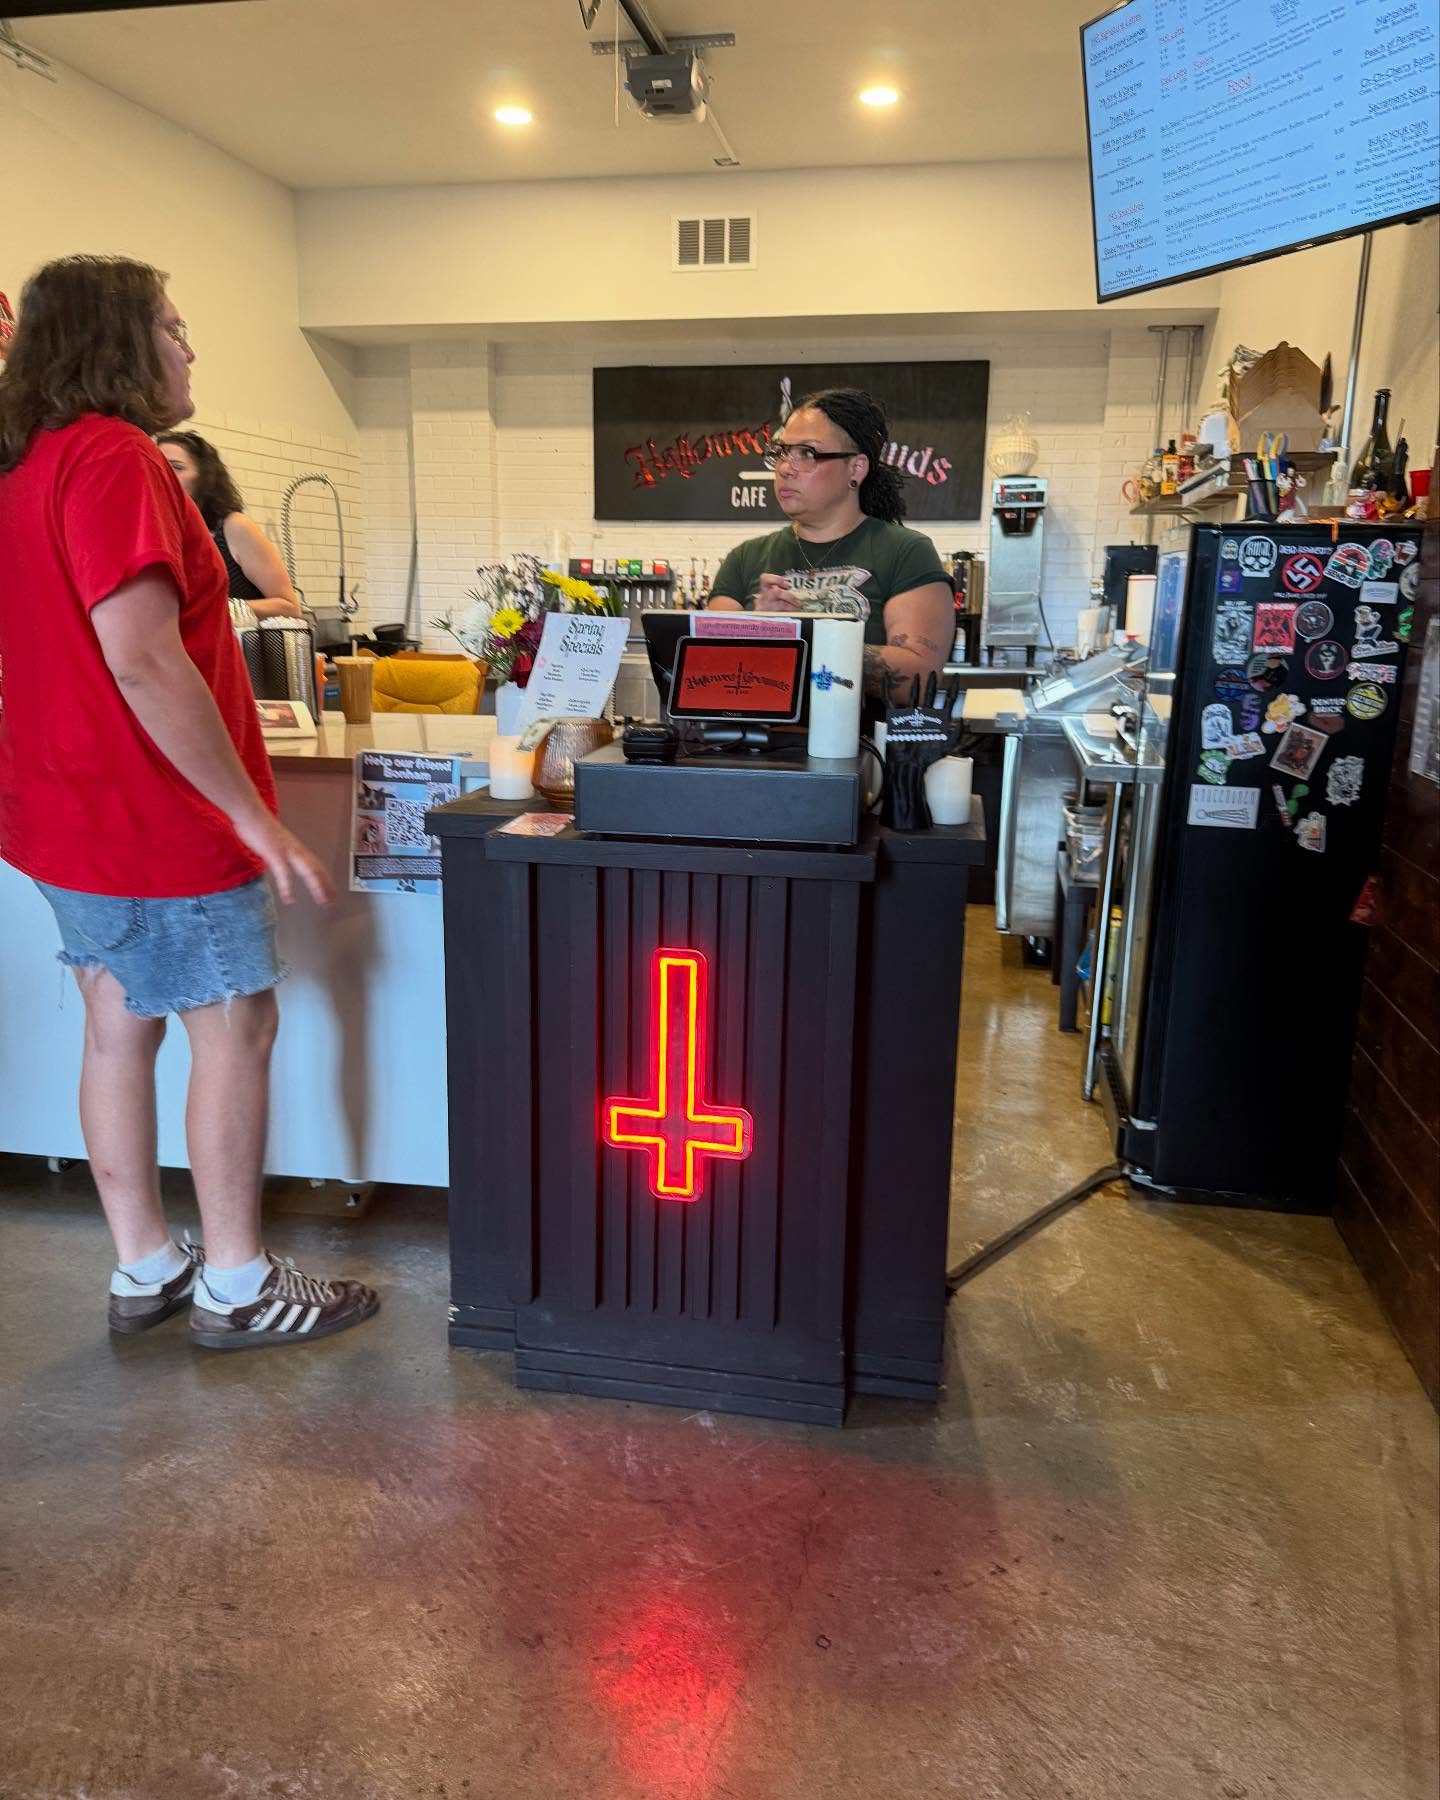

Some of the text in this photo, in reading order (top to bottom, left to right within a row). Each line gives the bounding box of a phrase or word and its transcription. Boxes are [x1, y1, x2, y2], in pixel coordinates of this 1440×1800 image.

[731, 485, 768, 508] CAFE
[568, 616, 606, 640] Spring
[559, 634, 605, 658] Specials
[364, 754, 453, 771] Help our friend
